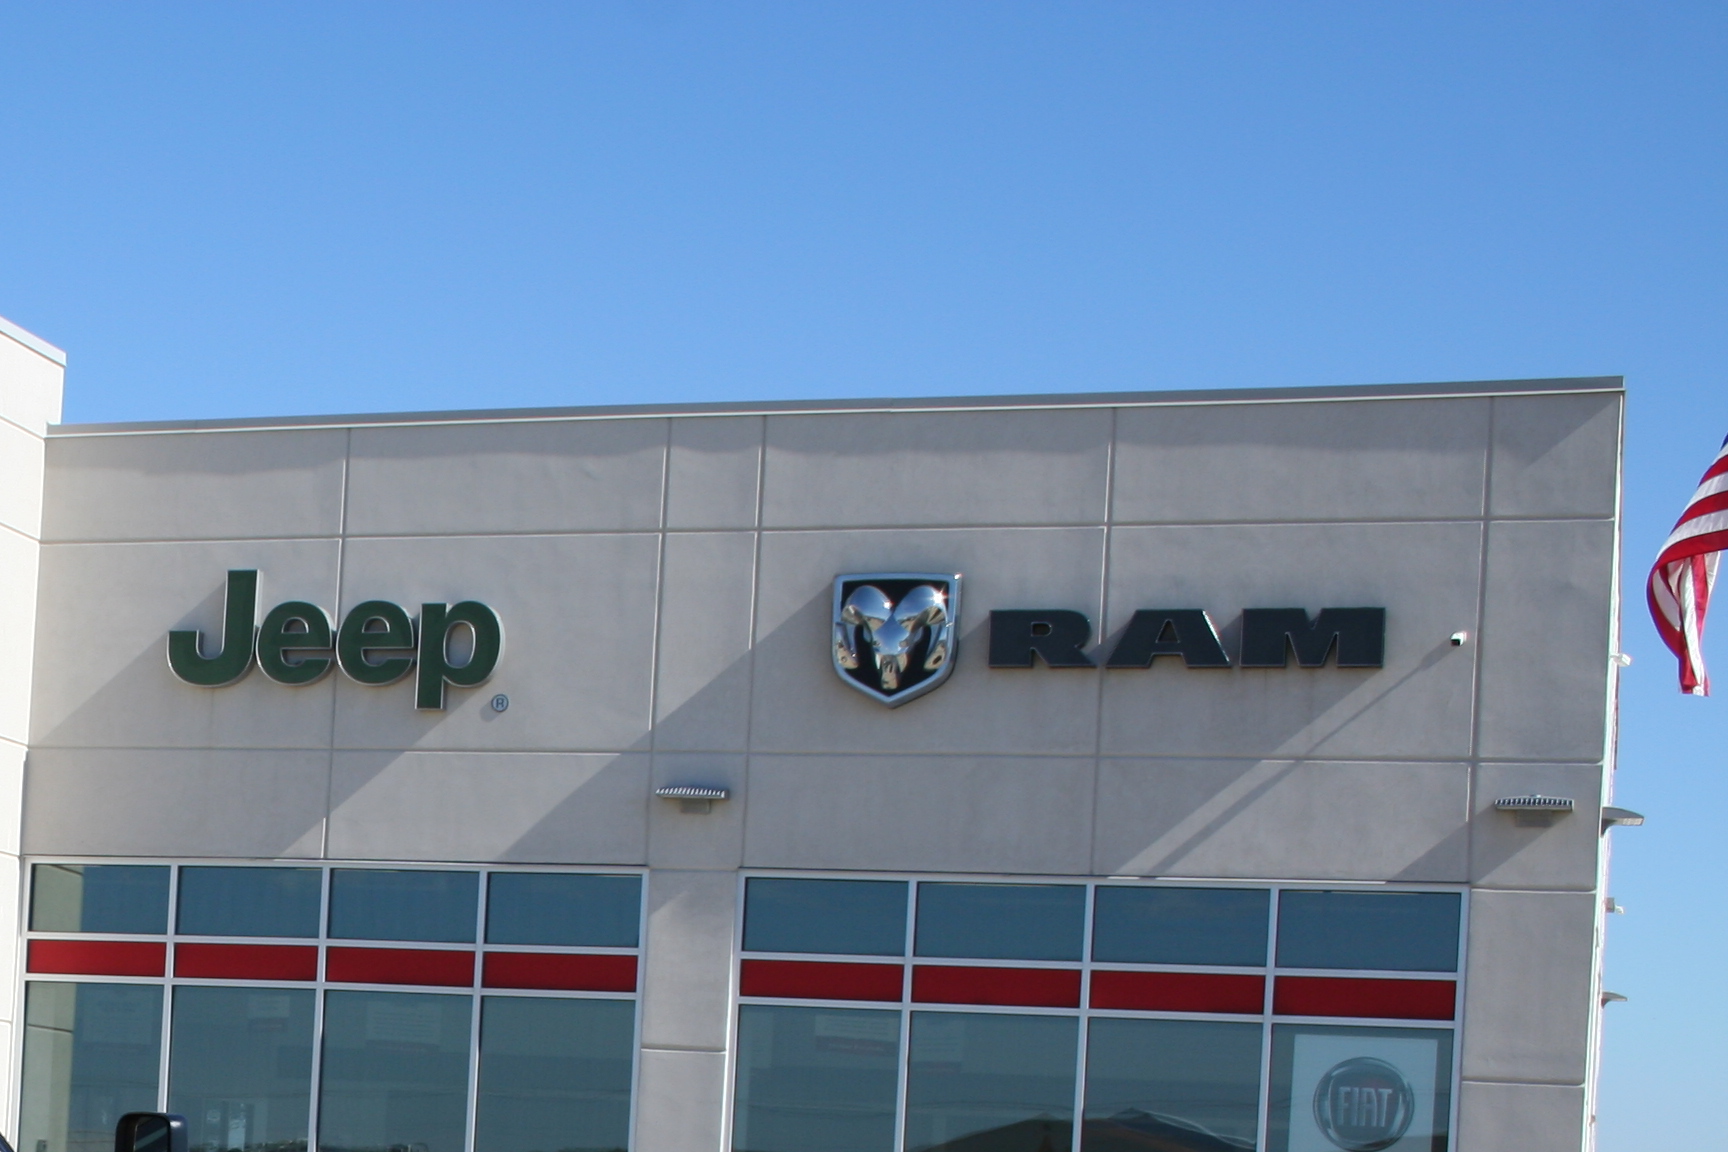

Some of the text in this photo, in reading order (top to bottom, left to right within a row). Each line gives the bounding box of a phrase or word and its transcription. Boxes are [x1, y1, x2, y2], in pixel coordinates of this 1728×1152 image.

[167, 569, 506, 711] Jeep
[988, 606, 1386, 669] RAM
[1336, 1086, 1393, 1128] FIAT
